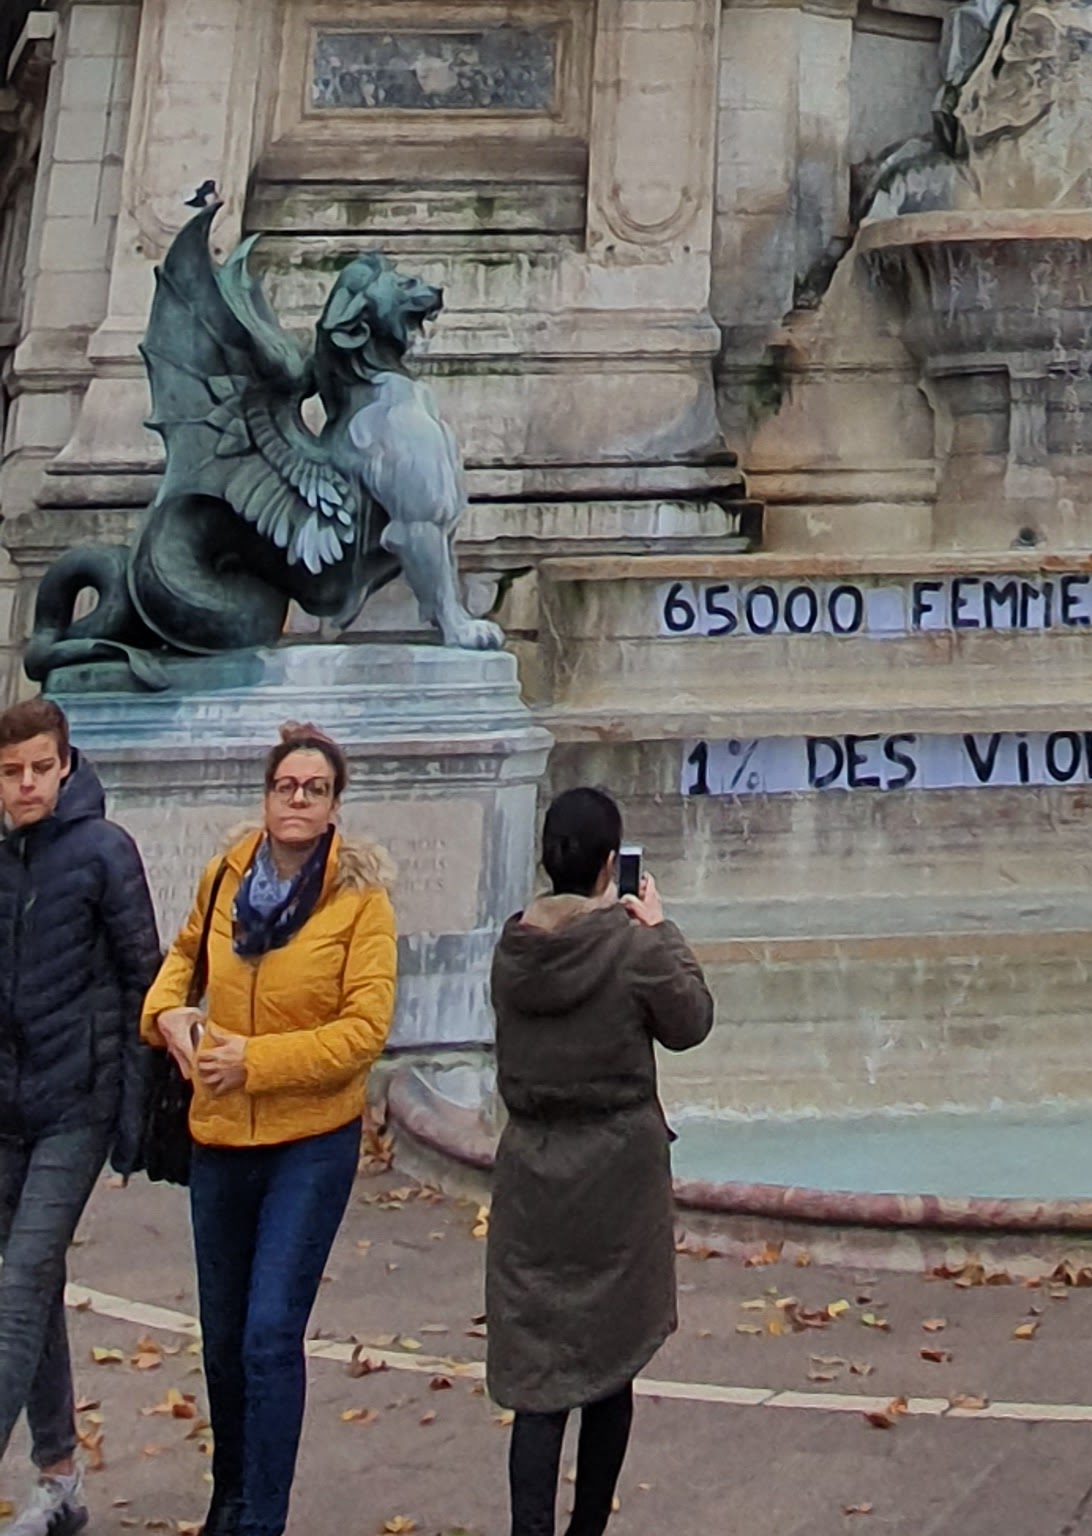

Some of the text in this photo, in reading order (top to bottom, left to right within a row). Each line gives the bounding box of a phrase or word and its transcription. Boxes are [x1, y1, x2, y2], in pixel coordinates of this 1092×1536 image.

[664, 582, 864, 636] 65000
[686, 738, 761, 796] 1%
[806, 733, 918, 790] DES
